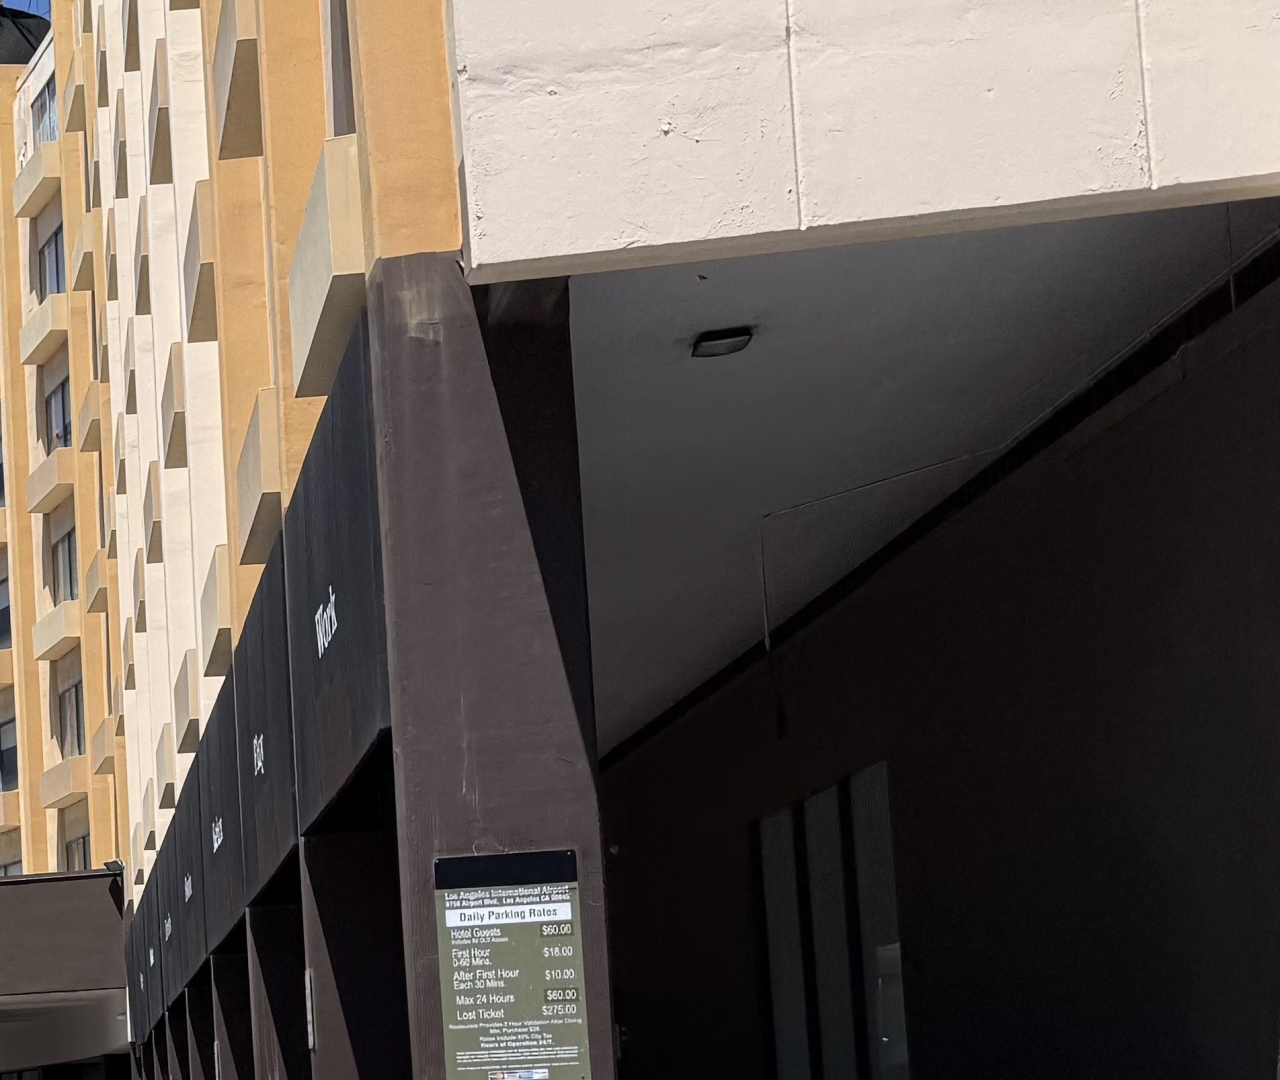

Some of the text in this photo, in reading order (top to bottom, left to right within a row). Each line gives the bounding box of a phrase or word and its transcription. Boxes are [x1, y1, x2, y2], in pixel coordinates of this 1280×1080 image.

[315, 585, 338, 659] Work
[444, 892, 458, 901] Los
[460, 907, 558, 923] Daily Parking Rates
[450, 924, 572, 939] Hotel Guests $60.00
[452, 946, 573, 958] First Hour $18.00
[452, 958, 492, 967] 0-60 Mins.
[453, 968, 575, 981] After First Hour $10.00
[453, 979, 506, 990] Each 30 Mins.
[456, 990, 577, 1005] Max 24 Hours $60.00
[457, 1004, 577, 1020] Lost Ticket $275.00
